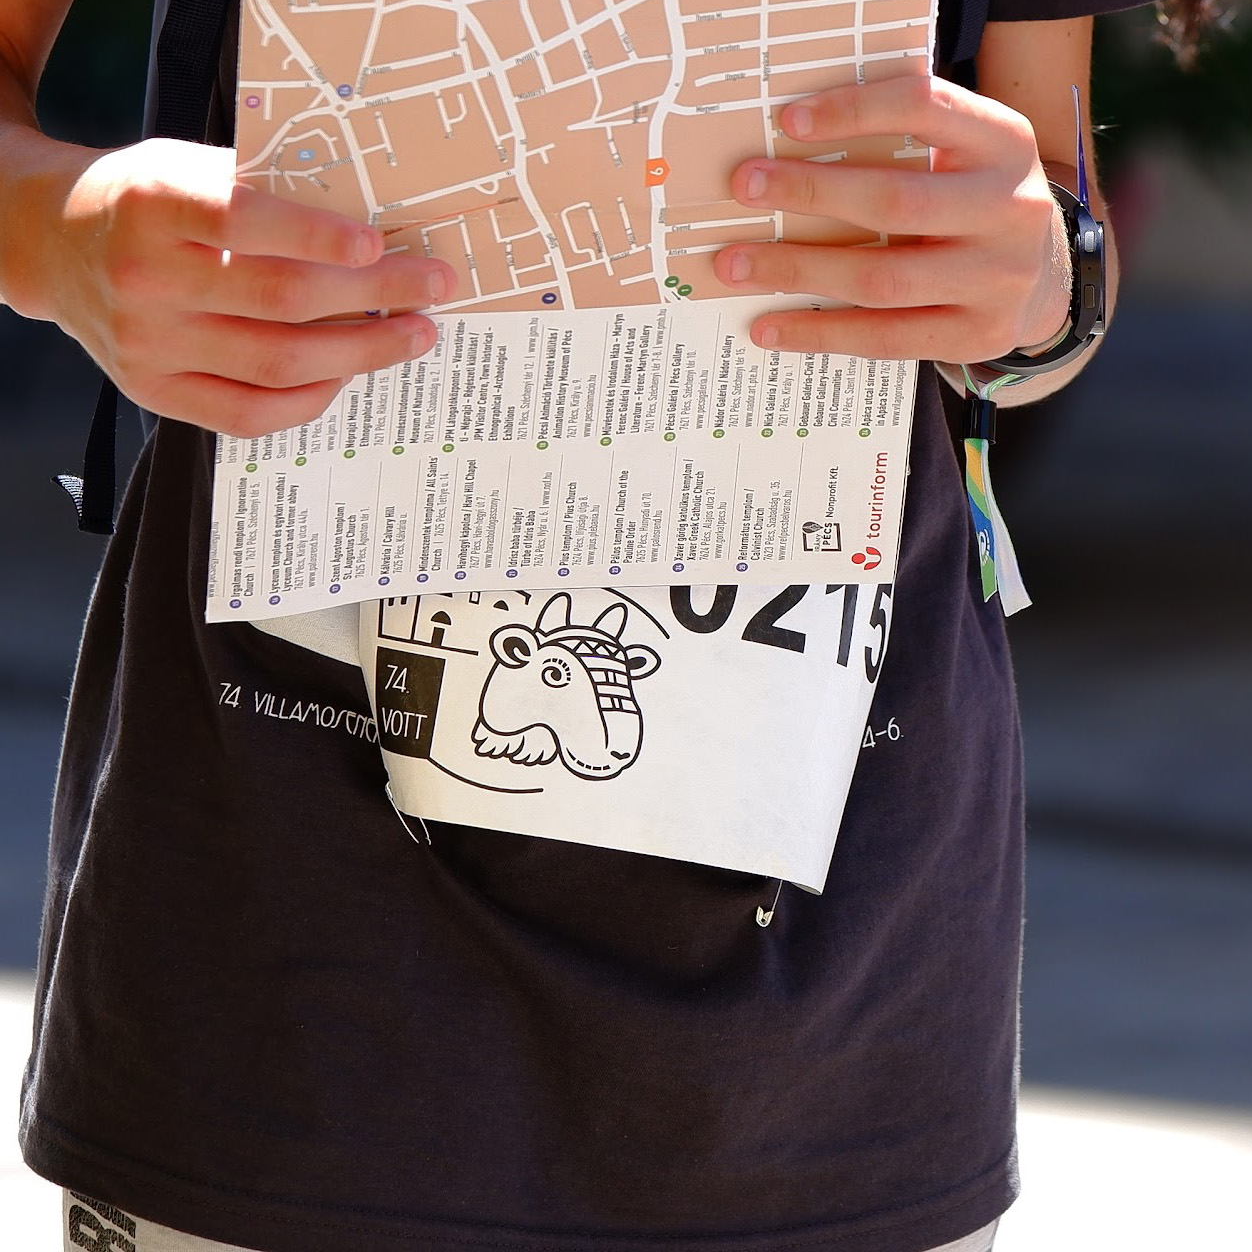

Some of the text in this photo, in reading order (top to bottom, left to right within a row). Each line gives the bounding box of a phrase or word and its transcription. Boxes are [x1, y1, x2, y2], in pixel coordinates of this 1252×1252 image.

[823, 480, 839, 518] Nonprofit
[864, 451, 887, 539] tourinform
[819, 522, 832, 545] PÉCS
[384, 664, 410, 694] 74.
[381, 707, 428, 740] VOTT
